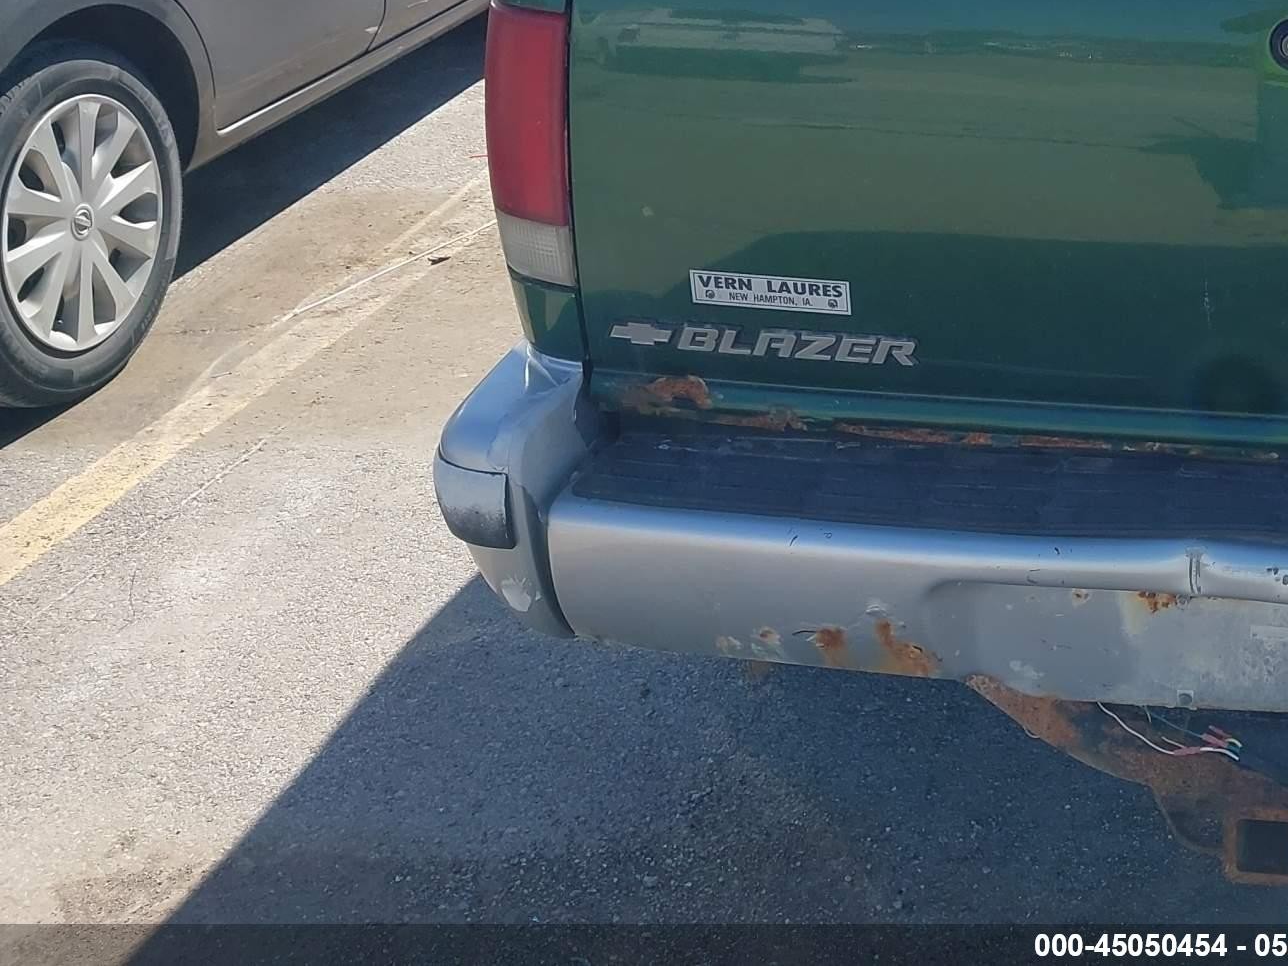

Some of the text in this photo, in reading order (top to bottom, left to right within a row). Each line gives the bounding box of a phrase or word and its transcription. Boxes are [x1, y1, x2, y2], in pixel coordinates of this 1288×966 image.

[697, 275, 843, 298] VERN LAURES
[728, 292, 749, 302] NEW
[753, 293, 798, 307] HAMPTON,
[676, 325, 918, 367] BLAZER
